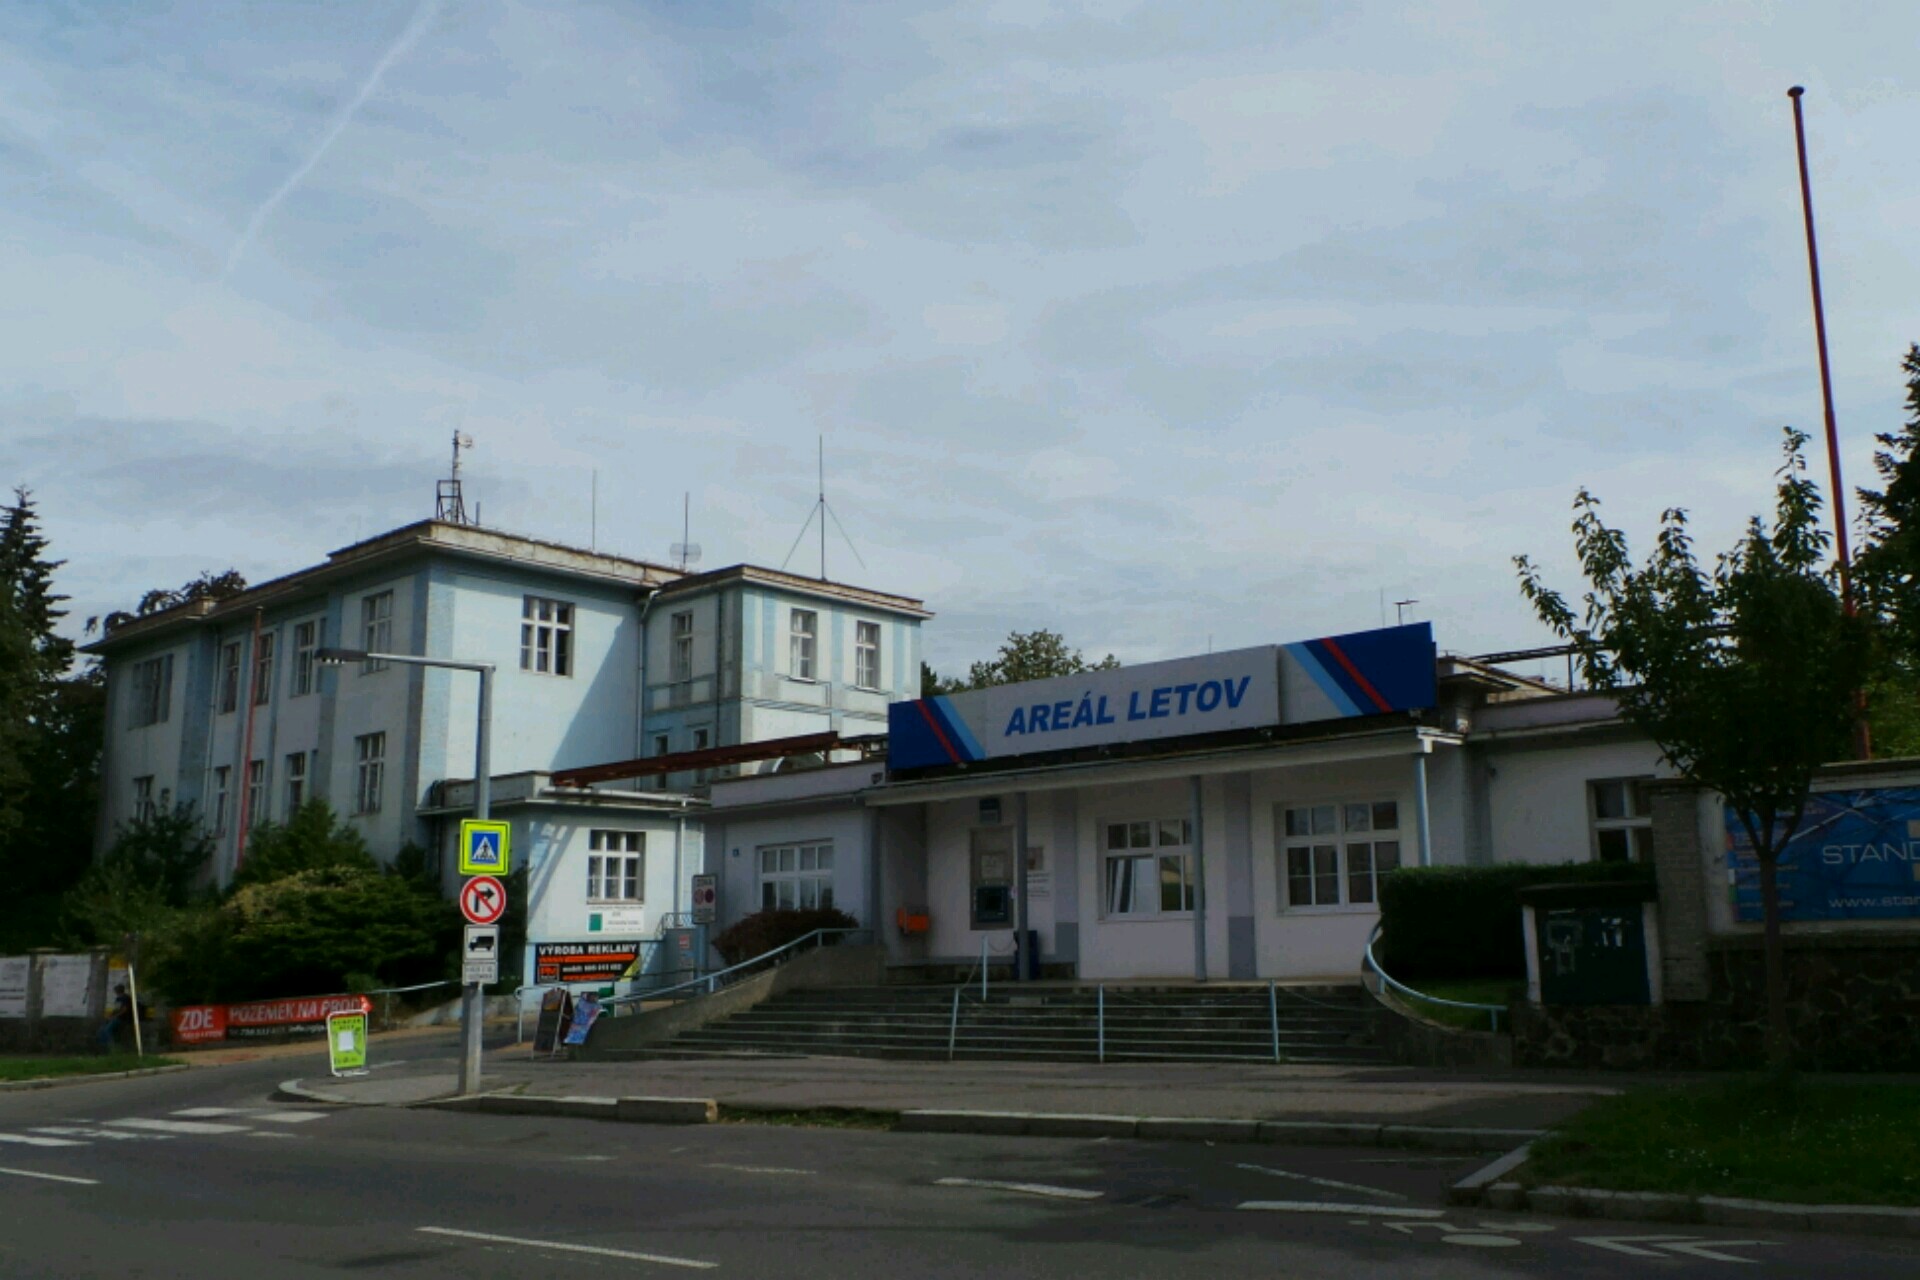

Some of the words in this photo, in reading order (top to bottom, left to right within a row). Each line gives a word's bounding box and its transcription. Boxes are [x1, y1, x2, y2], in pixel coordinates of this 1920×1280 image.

[1005, 691, 1115, 737] AREÁL
[1127, 676, 1251, 722] LETOV
[539, 943, 584, 956] VÝROBA
[587, 943, 638, 954] REKLAMY
[178, 1007, 214, 1032] ZDE
[229, 1002, 296, 1022] POZEMEK
[298, 1000, 318, 1018] NA
